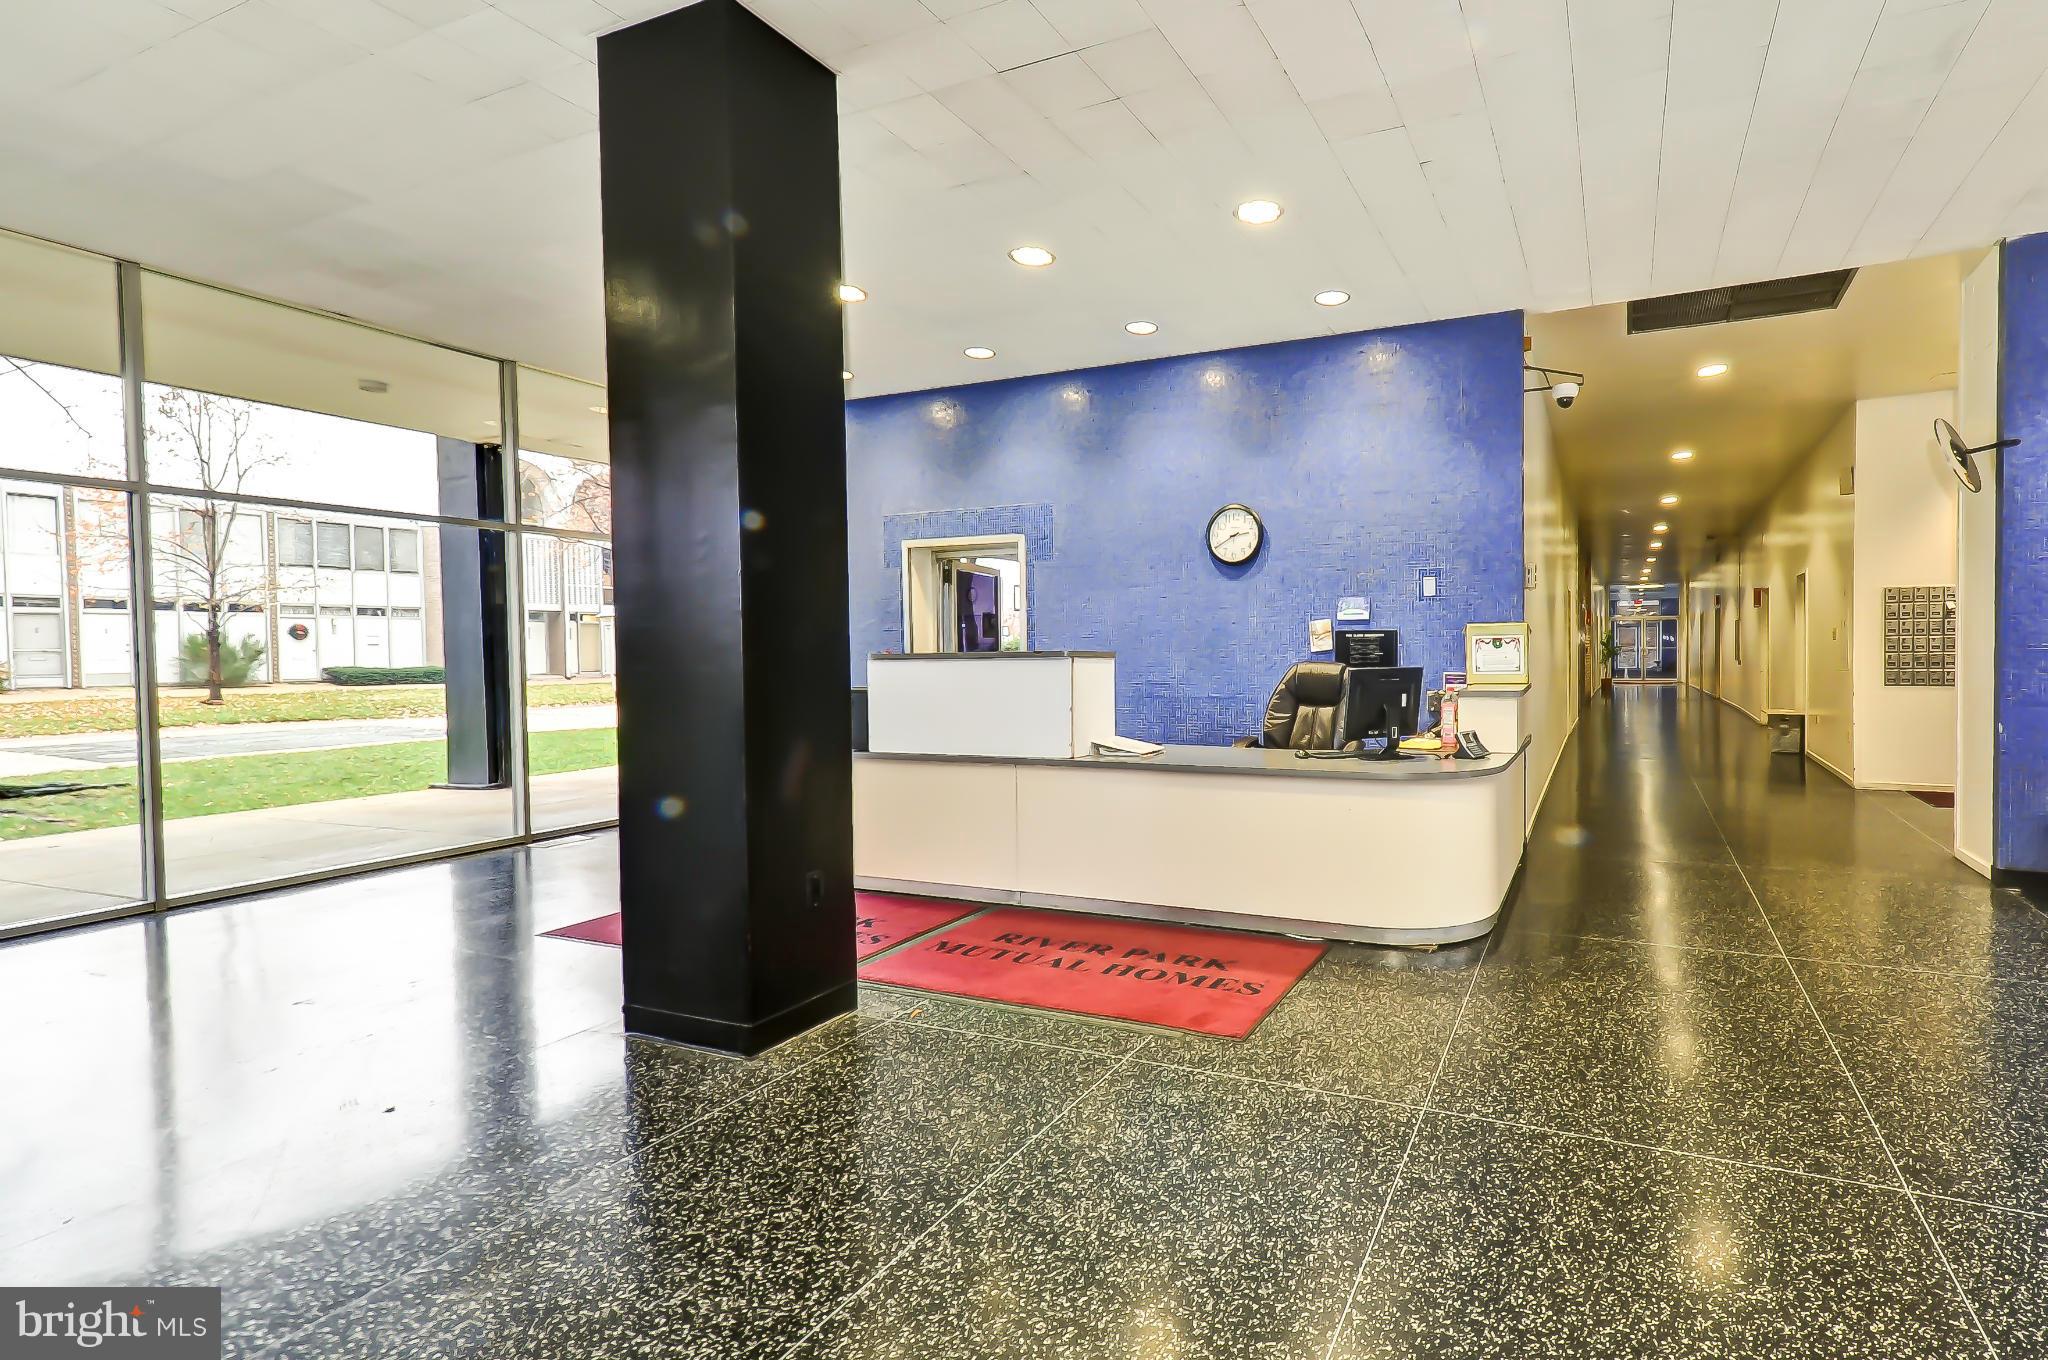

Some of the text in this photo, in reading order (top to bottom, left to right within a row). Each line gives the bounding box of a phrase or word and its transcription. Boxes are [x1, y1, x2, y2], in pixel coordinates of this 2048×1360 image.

[926, 940, 1266, 996] MUTUAL HOMES
[992, 932, 1240, 972] RIVER PARK
